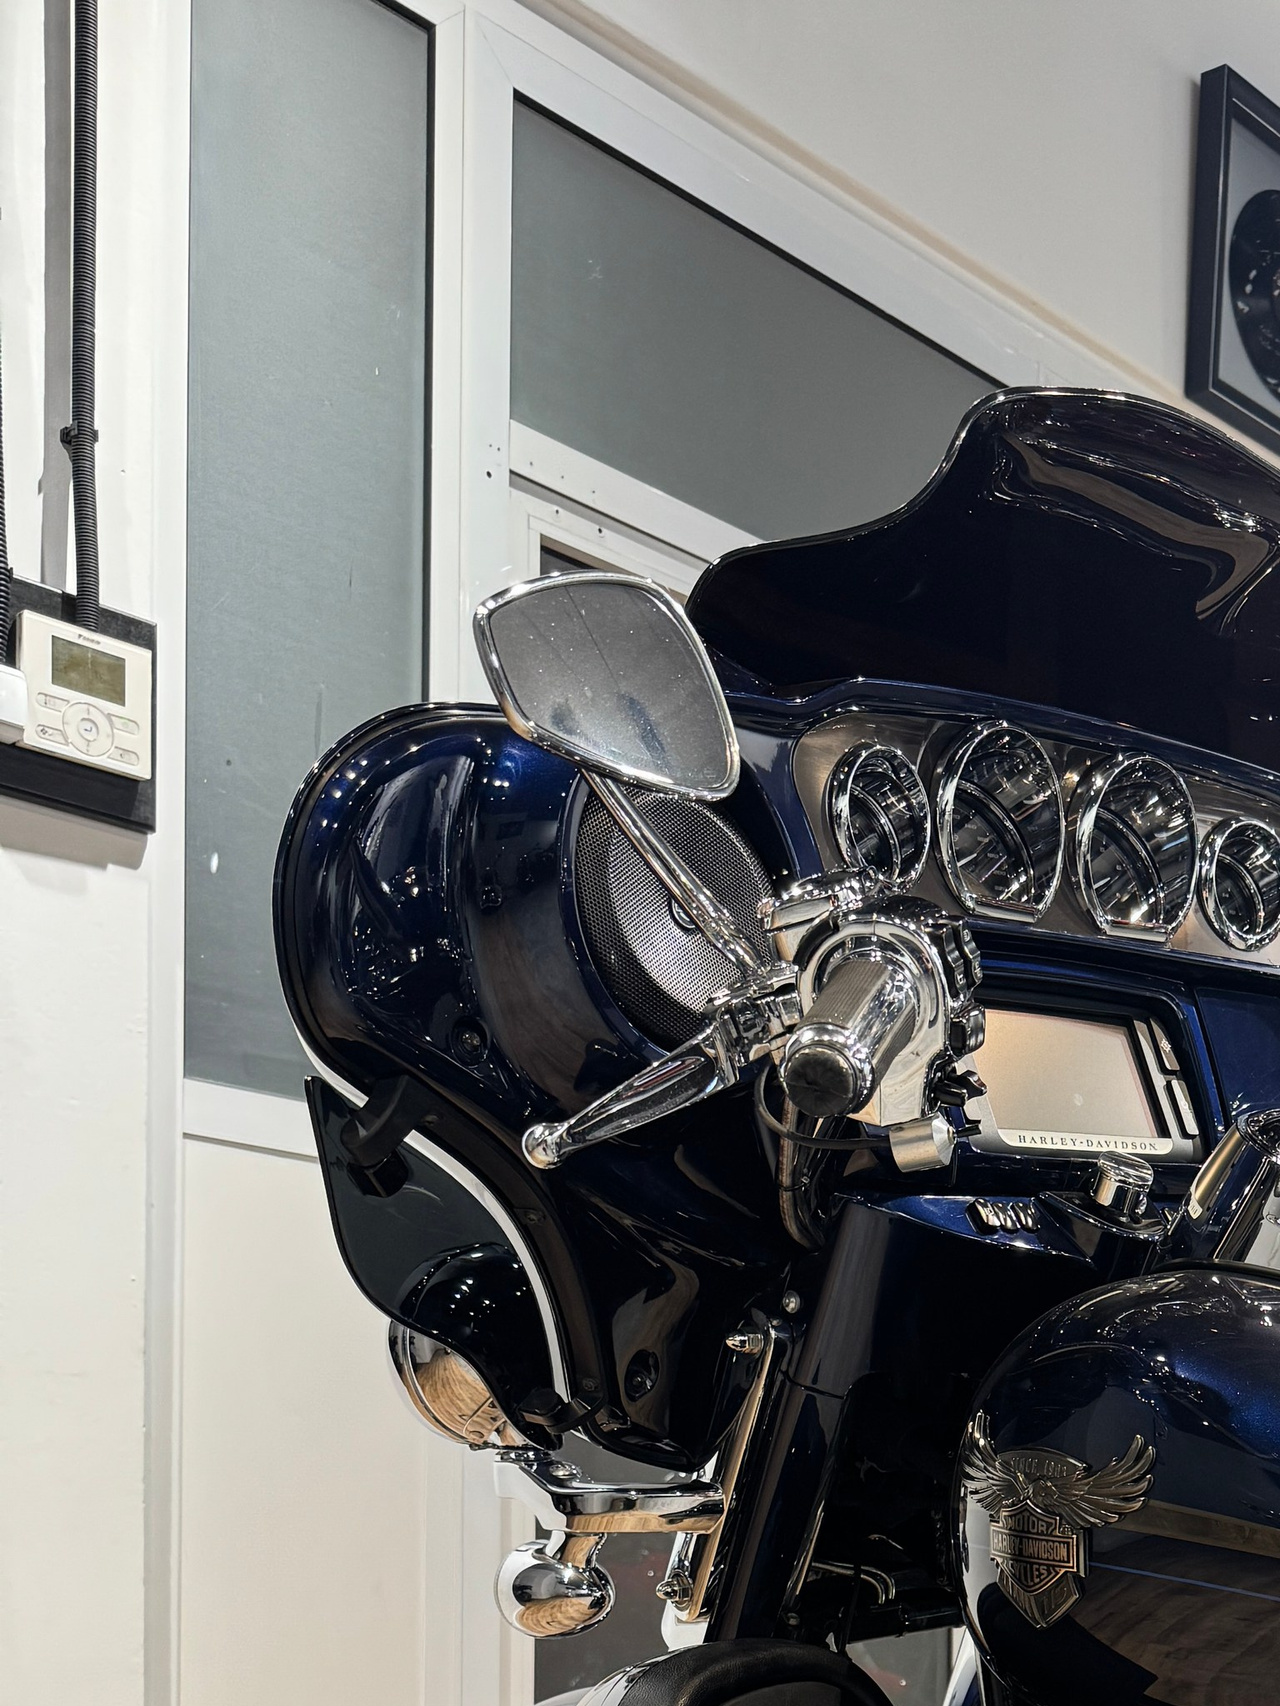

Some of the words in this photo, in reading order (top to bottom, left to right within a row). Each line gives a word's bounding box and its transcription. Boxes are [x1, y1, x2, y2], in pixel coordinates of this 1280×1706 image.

[1018, 1134, 1158, 1151] HARLEY-DAVIDSON
[1006, 1512, 1048, 1535] MOTOR
[992, 1532, 1068, 1562] HARLEY-DAVIDSON
[1008, 1560, 1048, 1586] CYCLES
